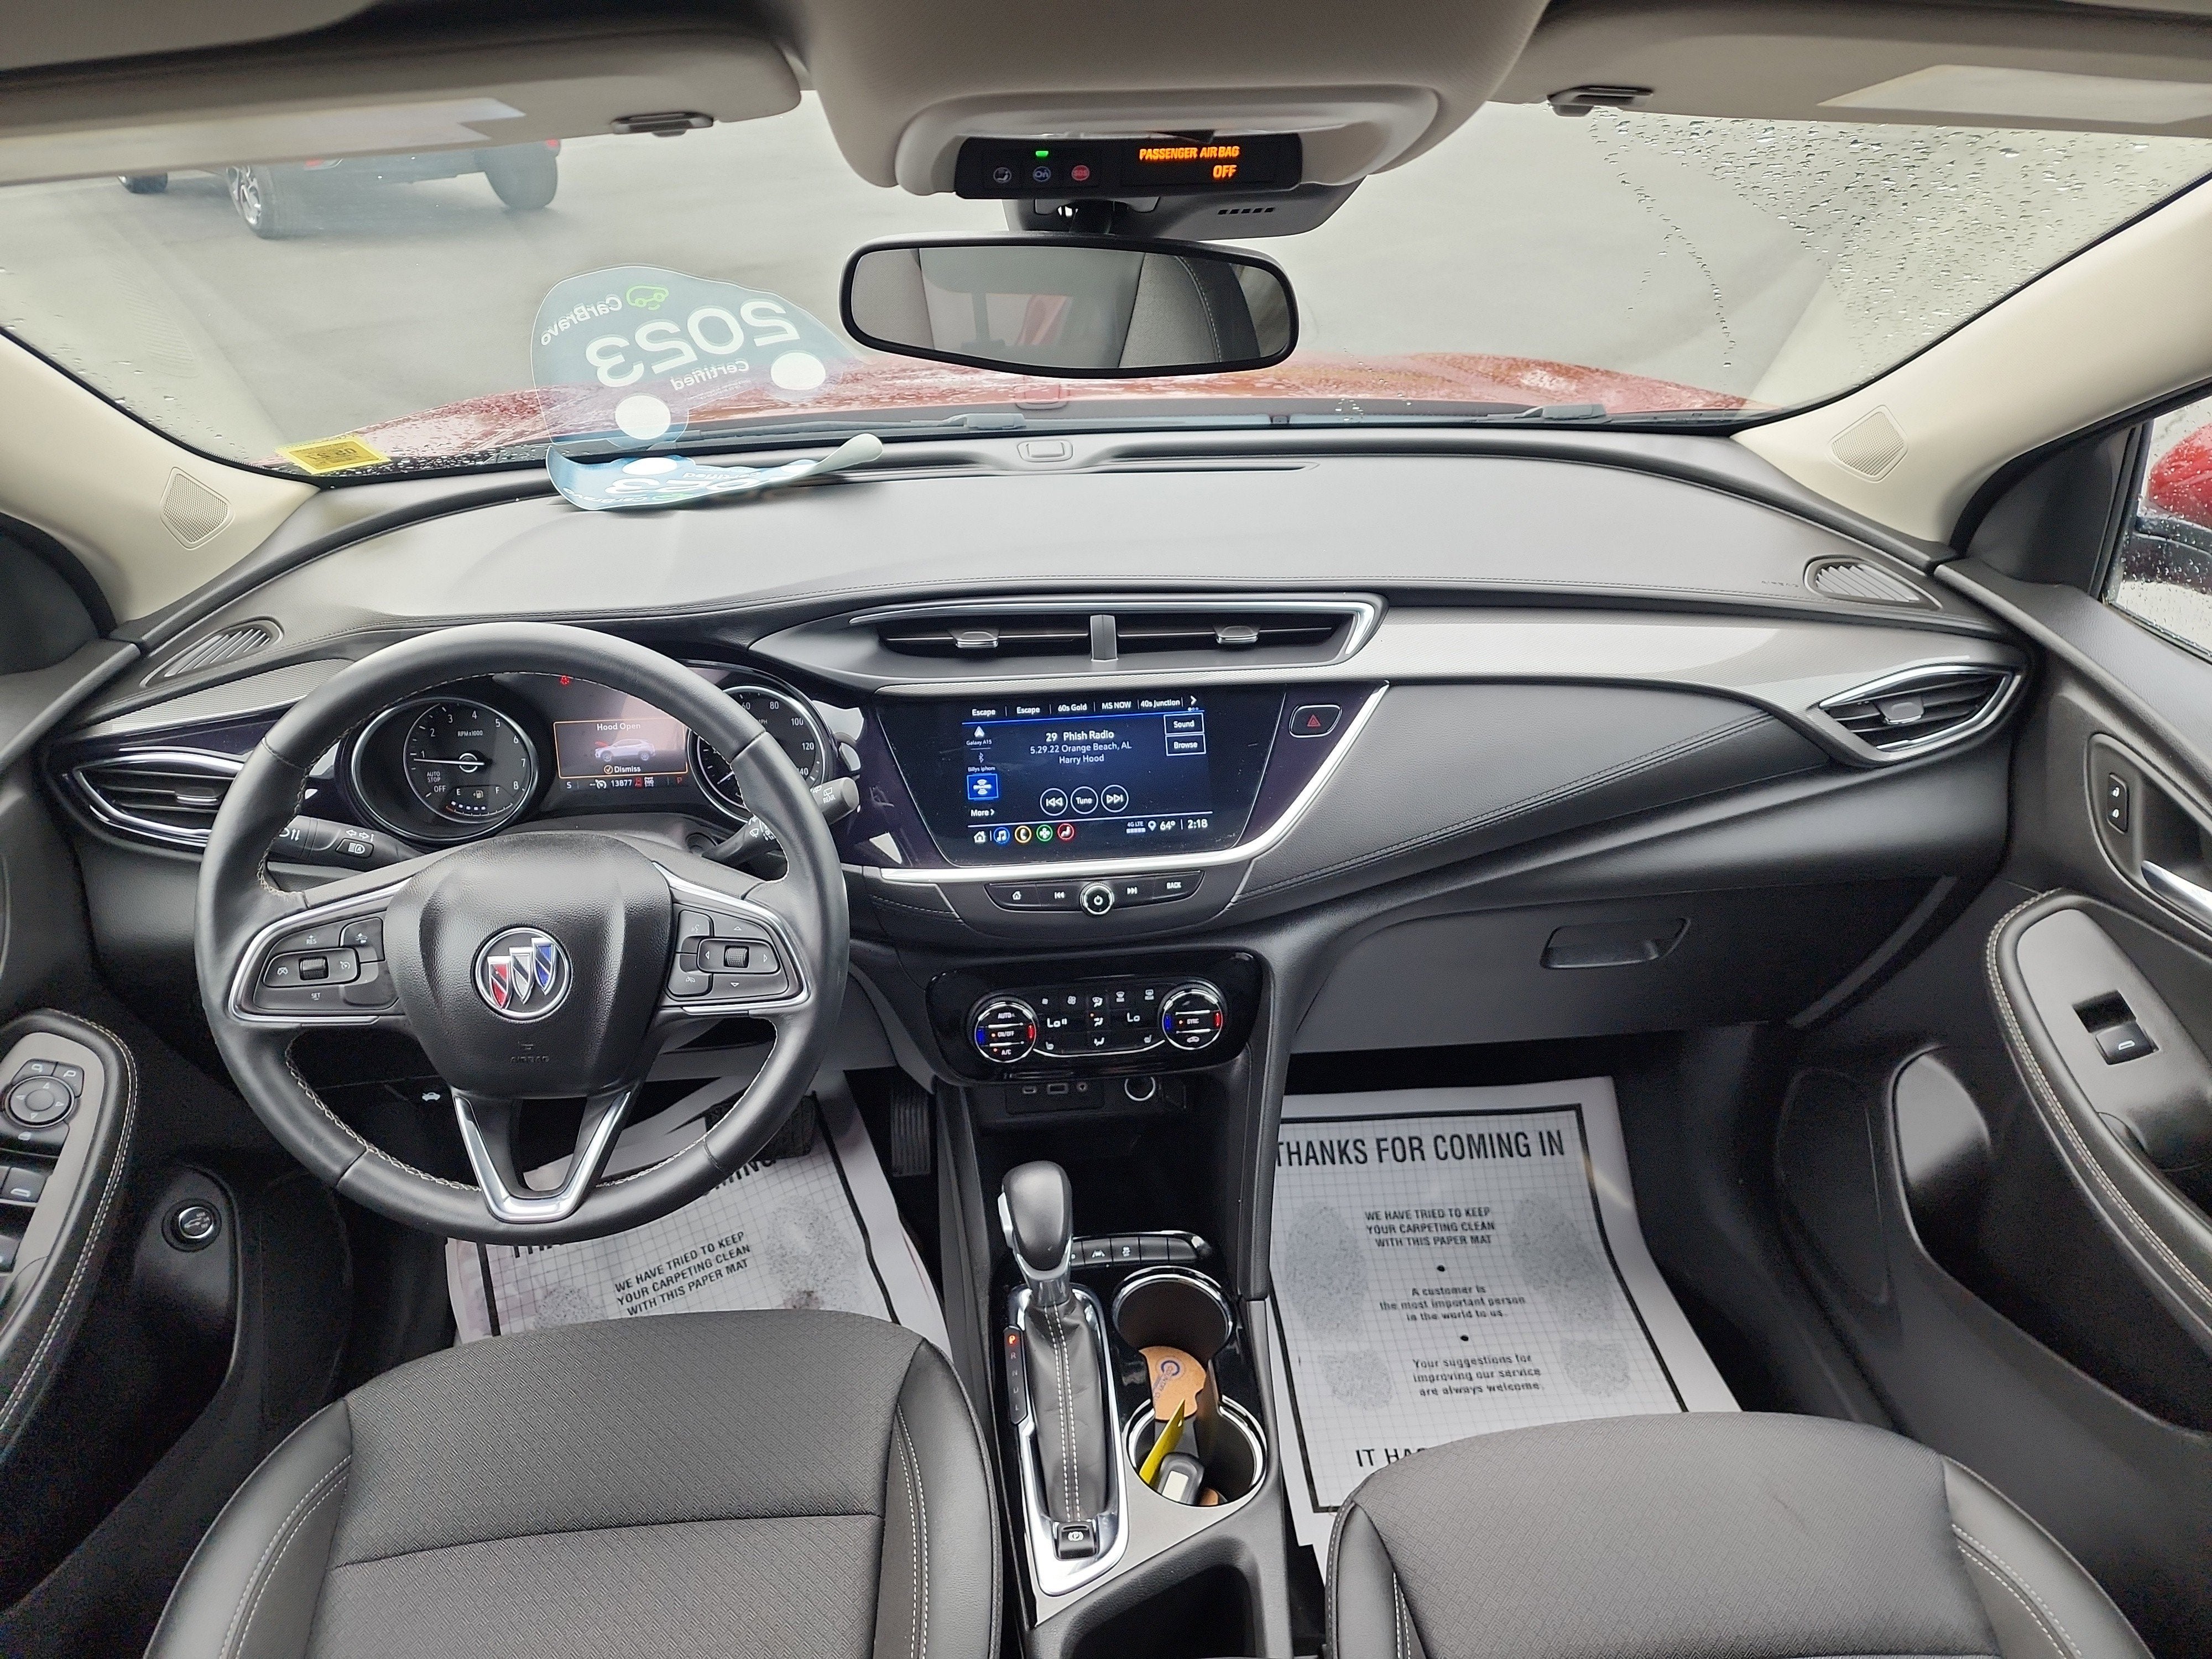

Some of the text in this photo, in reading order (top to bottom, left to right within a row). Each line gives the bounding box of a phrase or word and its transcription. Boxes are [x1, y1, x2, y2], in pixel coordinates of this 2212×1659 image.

[1140, 146, 1240, 160] PASSENGER AIR BAG
[1213, 165, 1237, 178] OFF
[770, 701, 779, 709] 80
[1154, 700, 1180, 708] Junction
[448, 714, 453, 723] 3
[472, 711, 477, 719] 4
[495, 719, 500, 727] 5
[597, 723, 640, 732] Hood Open
[791, 718, 804, 726] 100
[430, 729, 436, 737] 2
[1046, 729, 1114, 742] 29 Phish Radio
[513, 735, 519, 744] 6
[802, 742, 815, 750] 120
[1030, 741, 1132, 754] 5.29.22 Orange Beach, AL
[521, 759, 526, 768] 7
[1059, 754, 1104, 765] Harry Hood
[513, 781, 519, 790] 8
[1187, 819, 1208, 829] 2:18
[1127, 1013, 1140, 1022] Lo
[1047, 1018, 1061, 1029] Lo
[1277, 1130, 1564, 1166] THANKS FOR COMING IN
[1364, 1207, 1490, 1220] WE HAVE TRIED TO KEEP
[1366, 1220, 1494, 1234] YOUR CARPETING CLEAN
[1375, 1234, 1492, 1247] WITH THIS PAPER MAT
[615, 1232, 744, 1292] WE HAVE TRIED TO KEEP
[617, 1245, 750, 1306] YOUR CARPETING CLEAN
[627, 1258, 748, 1316] WITH THIS PAPER MAT
[1412, 1288, 1420, 1296] A
[1422, 1286, 1473, 1296] customer
[1379, 1296, 1526, 1310] the most important person
[1420, 1312, 1438, 1321] the
[1441, 1310, 1473, 1319] world
[1008, 1335, 1016, 1344] P
[1412, 1353, 1531, 1368] Your suggestions for
[1413, 1368, 1541, 1383] improving our service
[1420, 1388, 1438, 1396] are
[1442, 1385, 1483, 1395] always
[1356, 1448, 1375, 1467] IT
